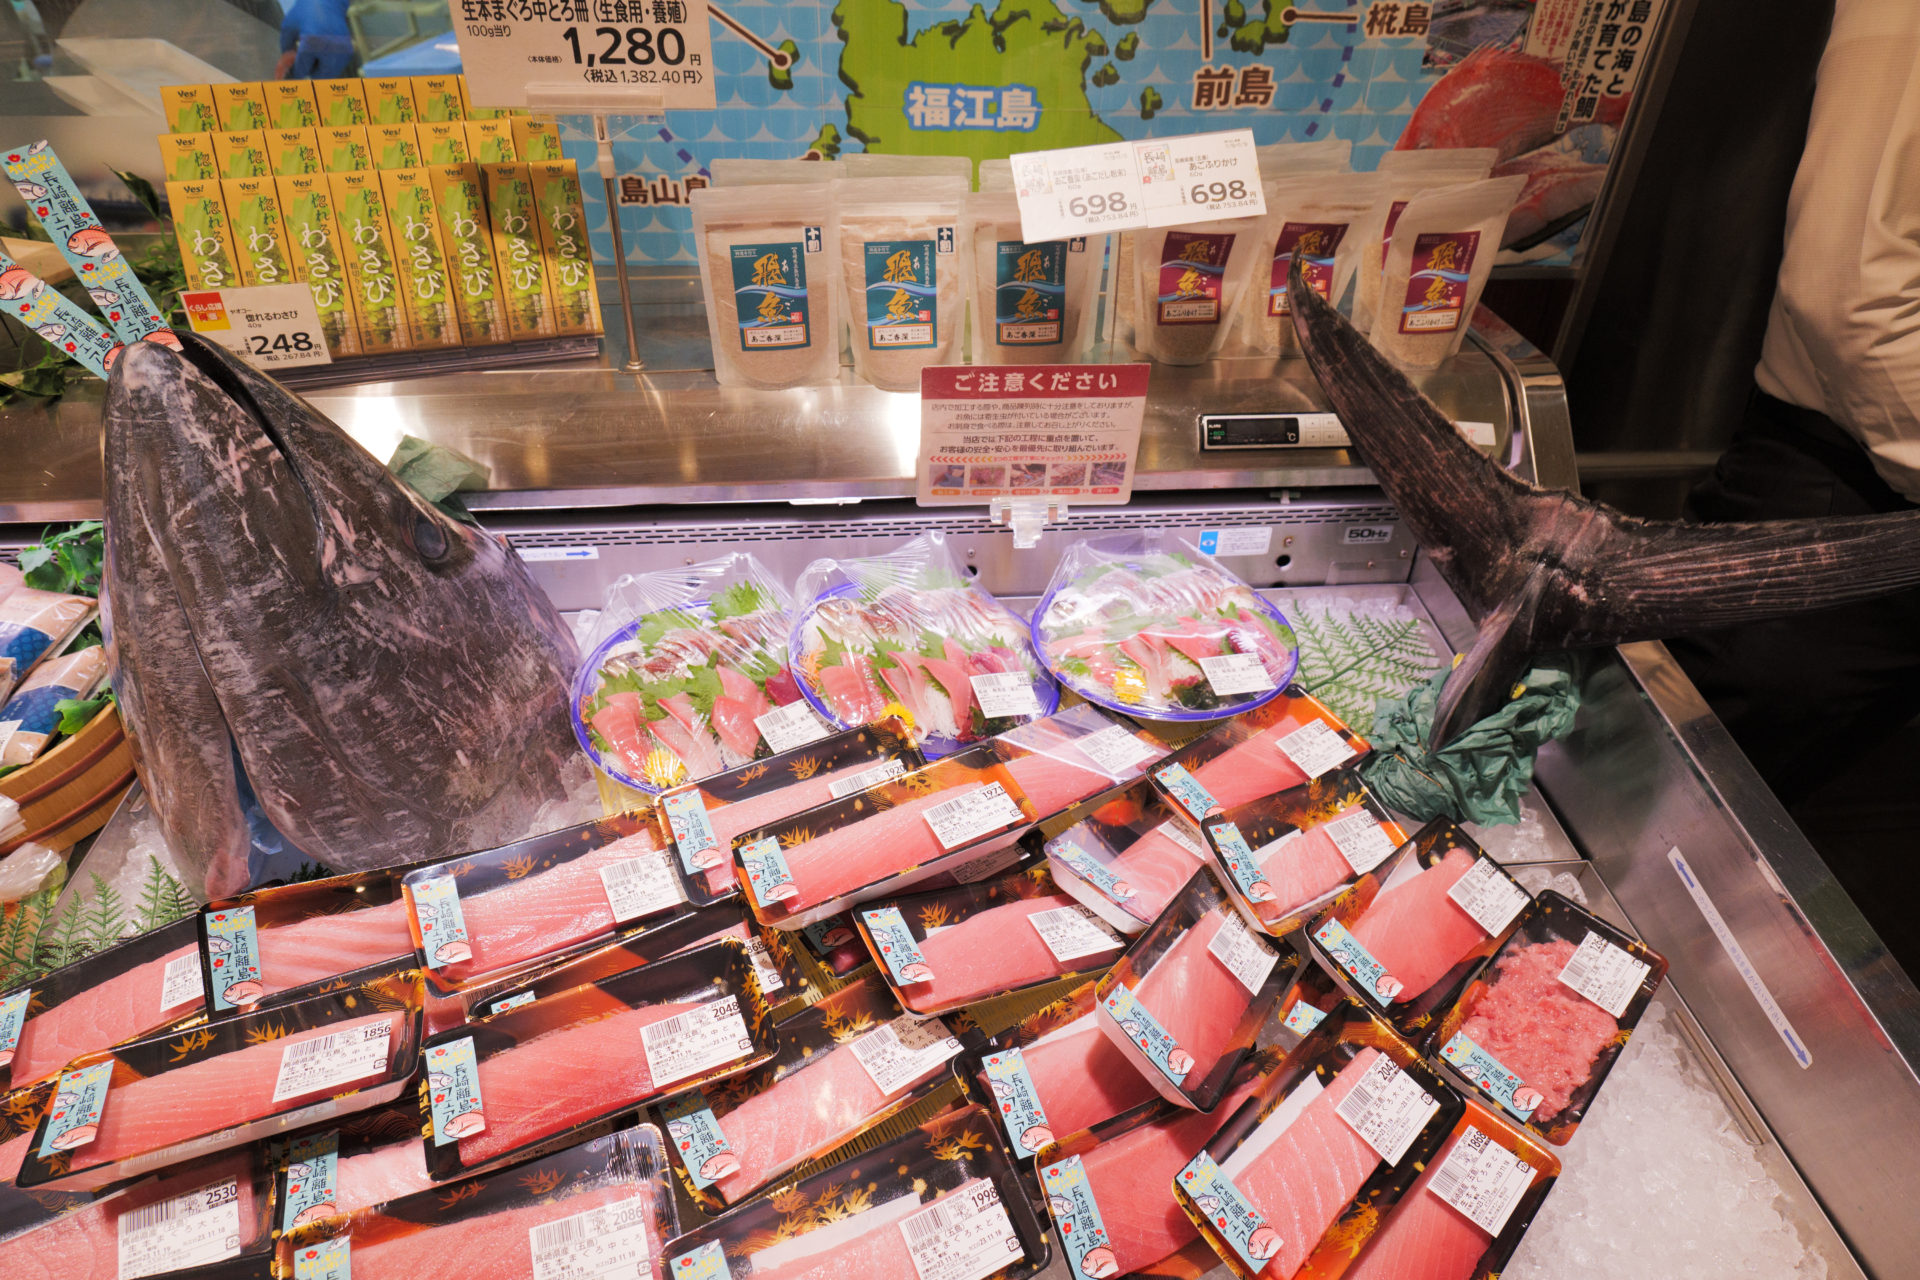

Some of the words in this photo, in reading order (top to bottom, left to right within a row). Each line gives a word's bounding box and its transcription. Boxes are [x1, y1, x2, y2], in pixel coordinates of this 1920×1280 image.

[466, 25, 512, 38] 100g当り
[1366, 4, 1432, 36] 椛島
[563, 27, 686, 67] 1,280
[690, 54, 701, 65] 円
[621, 71, 680, 84] 1,382.40
[1194, 67, 1275, 107] 前島
[908, 85, 1037, 129] 福江島
[345, 176, 364, 184] Yes!
[398, 173, 416, 181] Yes!
[445, 168, 463, 176] Yes!
[497, 167, 515, 176] Yes!
[546, 165, 564, 173] Yes!
[1189, 157, 1238, 170] あごふりかけ
[41, 171, 87, 229] 長崎離島
[184, 185, 204, 194] Yes!
[239, 182, 259, 191] Yes!
[293, 179, 312, 188] Yes!
[1191, 179, 1247, 205] 698
[38, 198, 70, 239] フェア
[1069, 192, 1128, 218] 698
[194, 230, 223, 286] わさ
[249, 226, 278, 282] わさ
[354, 219, 390, 303] わさび
[406, 216, 441, 298] わさび
[454, 212, 489, 296] わさび
[504, 208, 537, 290] わさび
[553, 206, 585, 287] わさび
[302, 222, 339, 307] わさび
[114, 278, 158, 332] 長崎離島
[53, 307, 111, 351] 長崎離島
[112, 303, 142, 342] フェア
[63, 332, 102, 365] フェア
[251, 332, 313, 355] 248
[284, 352, 311, 360] 267.84
[955, 371, 1117, 392] ご注意ください
[1348, 528, 1388, 538] 50Hz
[885, 766, 906, 777] 1920
[981, 785, 1004, 798] 1971
[660, 854, 672, 865] 17
[428, 915, 444, 949] フェア
[437, 895, 458, 941] 長崎離島
[233, 929, 251, 981] 長崎離島
[746, 942, 764, 954] 868
[885, 941, 907, 969] フェア
[889, 925, 917, 964] 長崎離島
[220, 951, 234, 988] フェア
[711, 1001, 739, 1018] 2048
[363, 1024, 390, 1038] 1856
[1377, 1058, 1397, 1080] 2042
[1469, 1051, 1518, 1092] 長崎離島
[440, 1084, 454, 1123] フェア
[452, 1061, 470, 1114] 長崎離島
[1010, 1072, 1039, 1127] 長崎離島
[1480, 1072, 1516, 1102] フェア
[54, 1103, 74, 1137] フェア
[71, 1081, 98, 1128] 長崎離島
[1005, 1096, 1028, 1135] フェア
[684, 1133, 707, 1168] フェア
[688, 1110, 719, 1158] 長崎離島
[1466, 1129, 1487, 1152] 1868
[205, 1183, 237, 1205] 2530
[294, 1176, 308, 1213] フェア
[310, 1154, 327, 1206] 長崎離島
[970, 1185, 999, 1209] 1998
[612, 1204, 643, 1225] 2086
[1069, 1184, 1097, 1249] 長崎離島
[1209, 1177, 1259, 1234] 長崎離島
[1063, 1213, 1084, 1260] フェア
[1216, 1207, 1252, 1248] フェア
